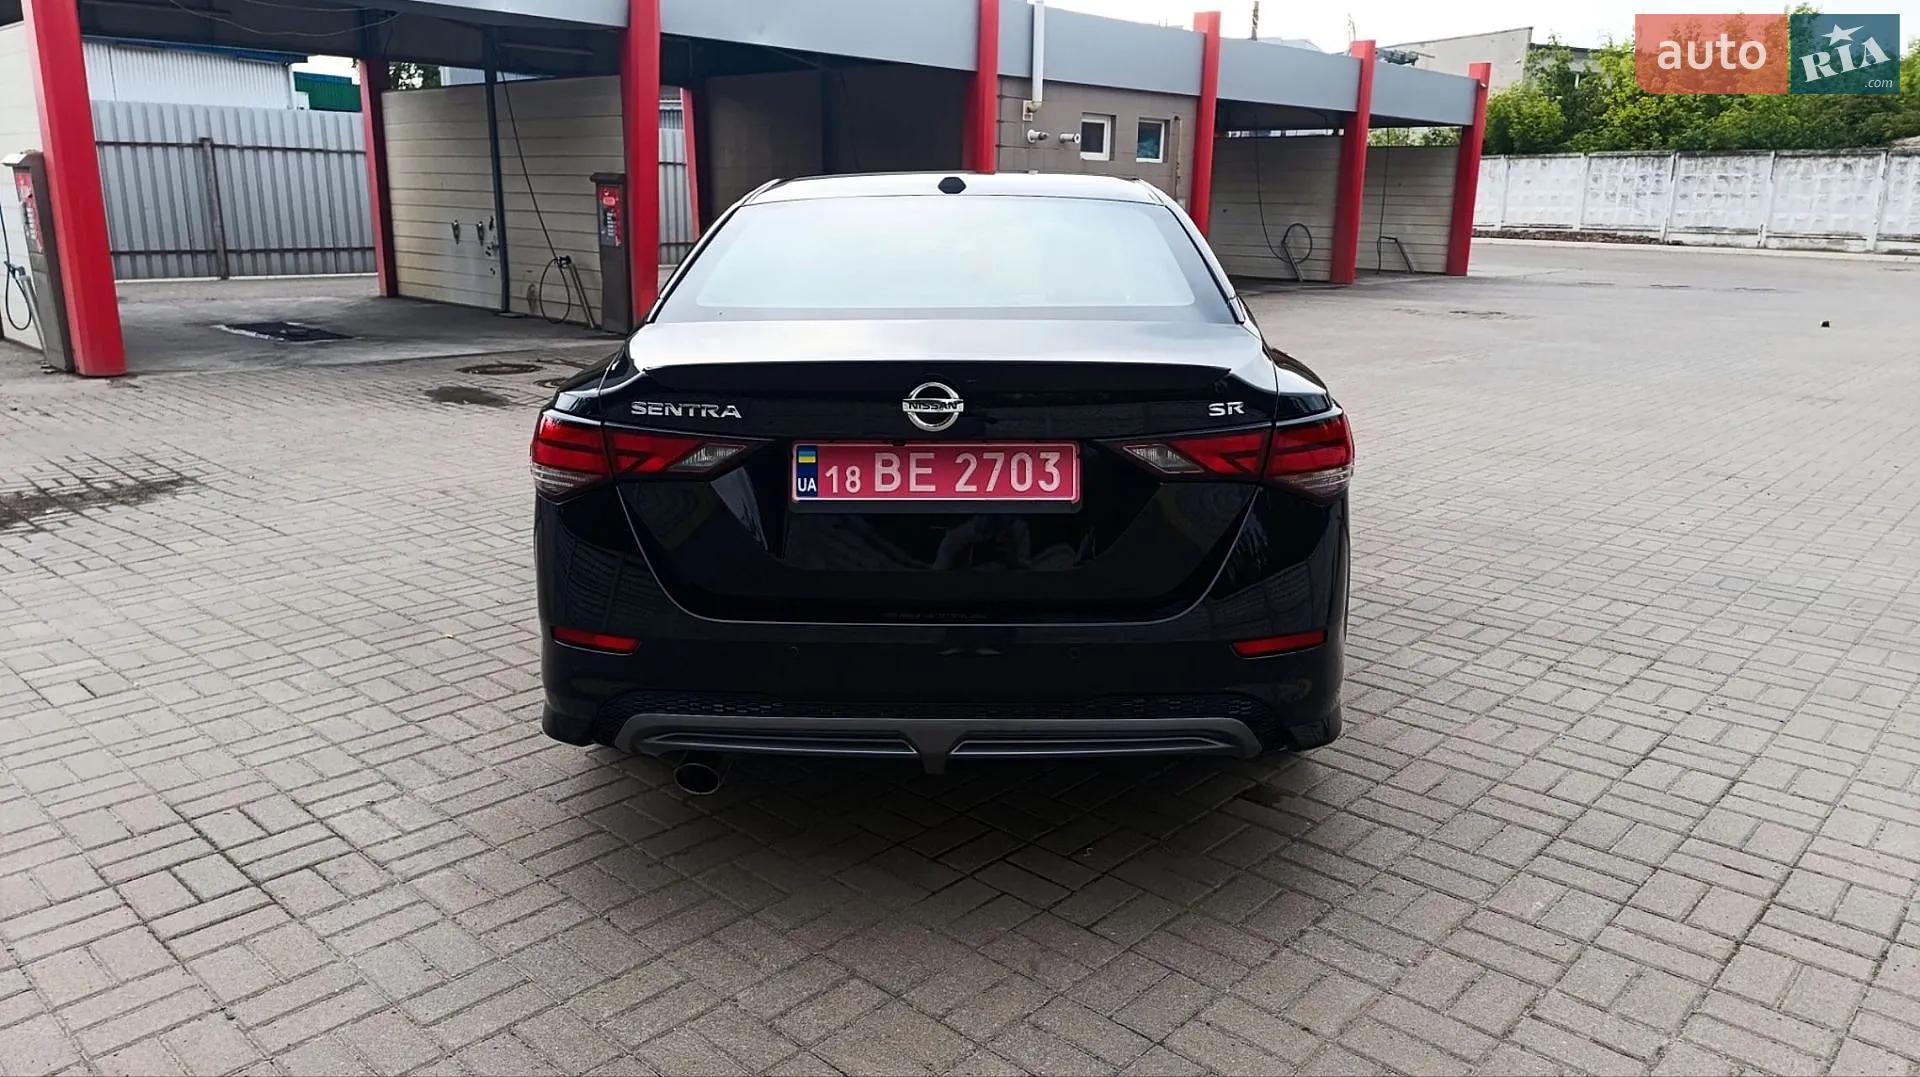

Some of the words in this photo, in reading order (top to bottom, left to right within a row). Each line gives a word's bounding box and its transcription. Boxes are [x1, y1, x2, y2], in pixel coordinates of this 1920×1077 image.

[631, 401, 742, 419] SENTRA
[908, 401, 958, 411] NISSAN
[1208, 401, 1245, 417] SR
[825, 465, 862, 494] 18
[874, 452, 937, 492] BE
[954, 452, 1061, 492] 2703
[798, 477, 818, 492] UA
